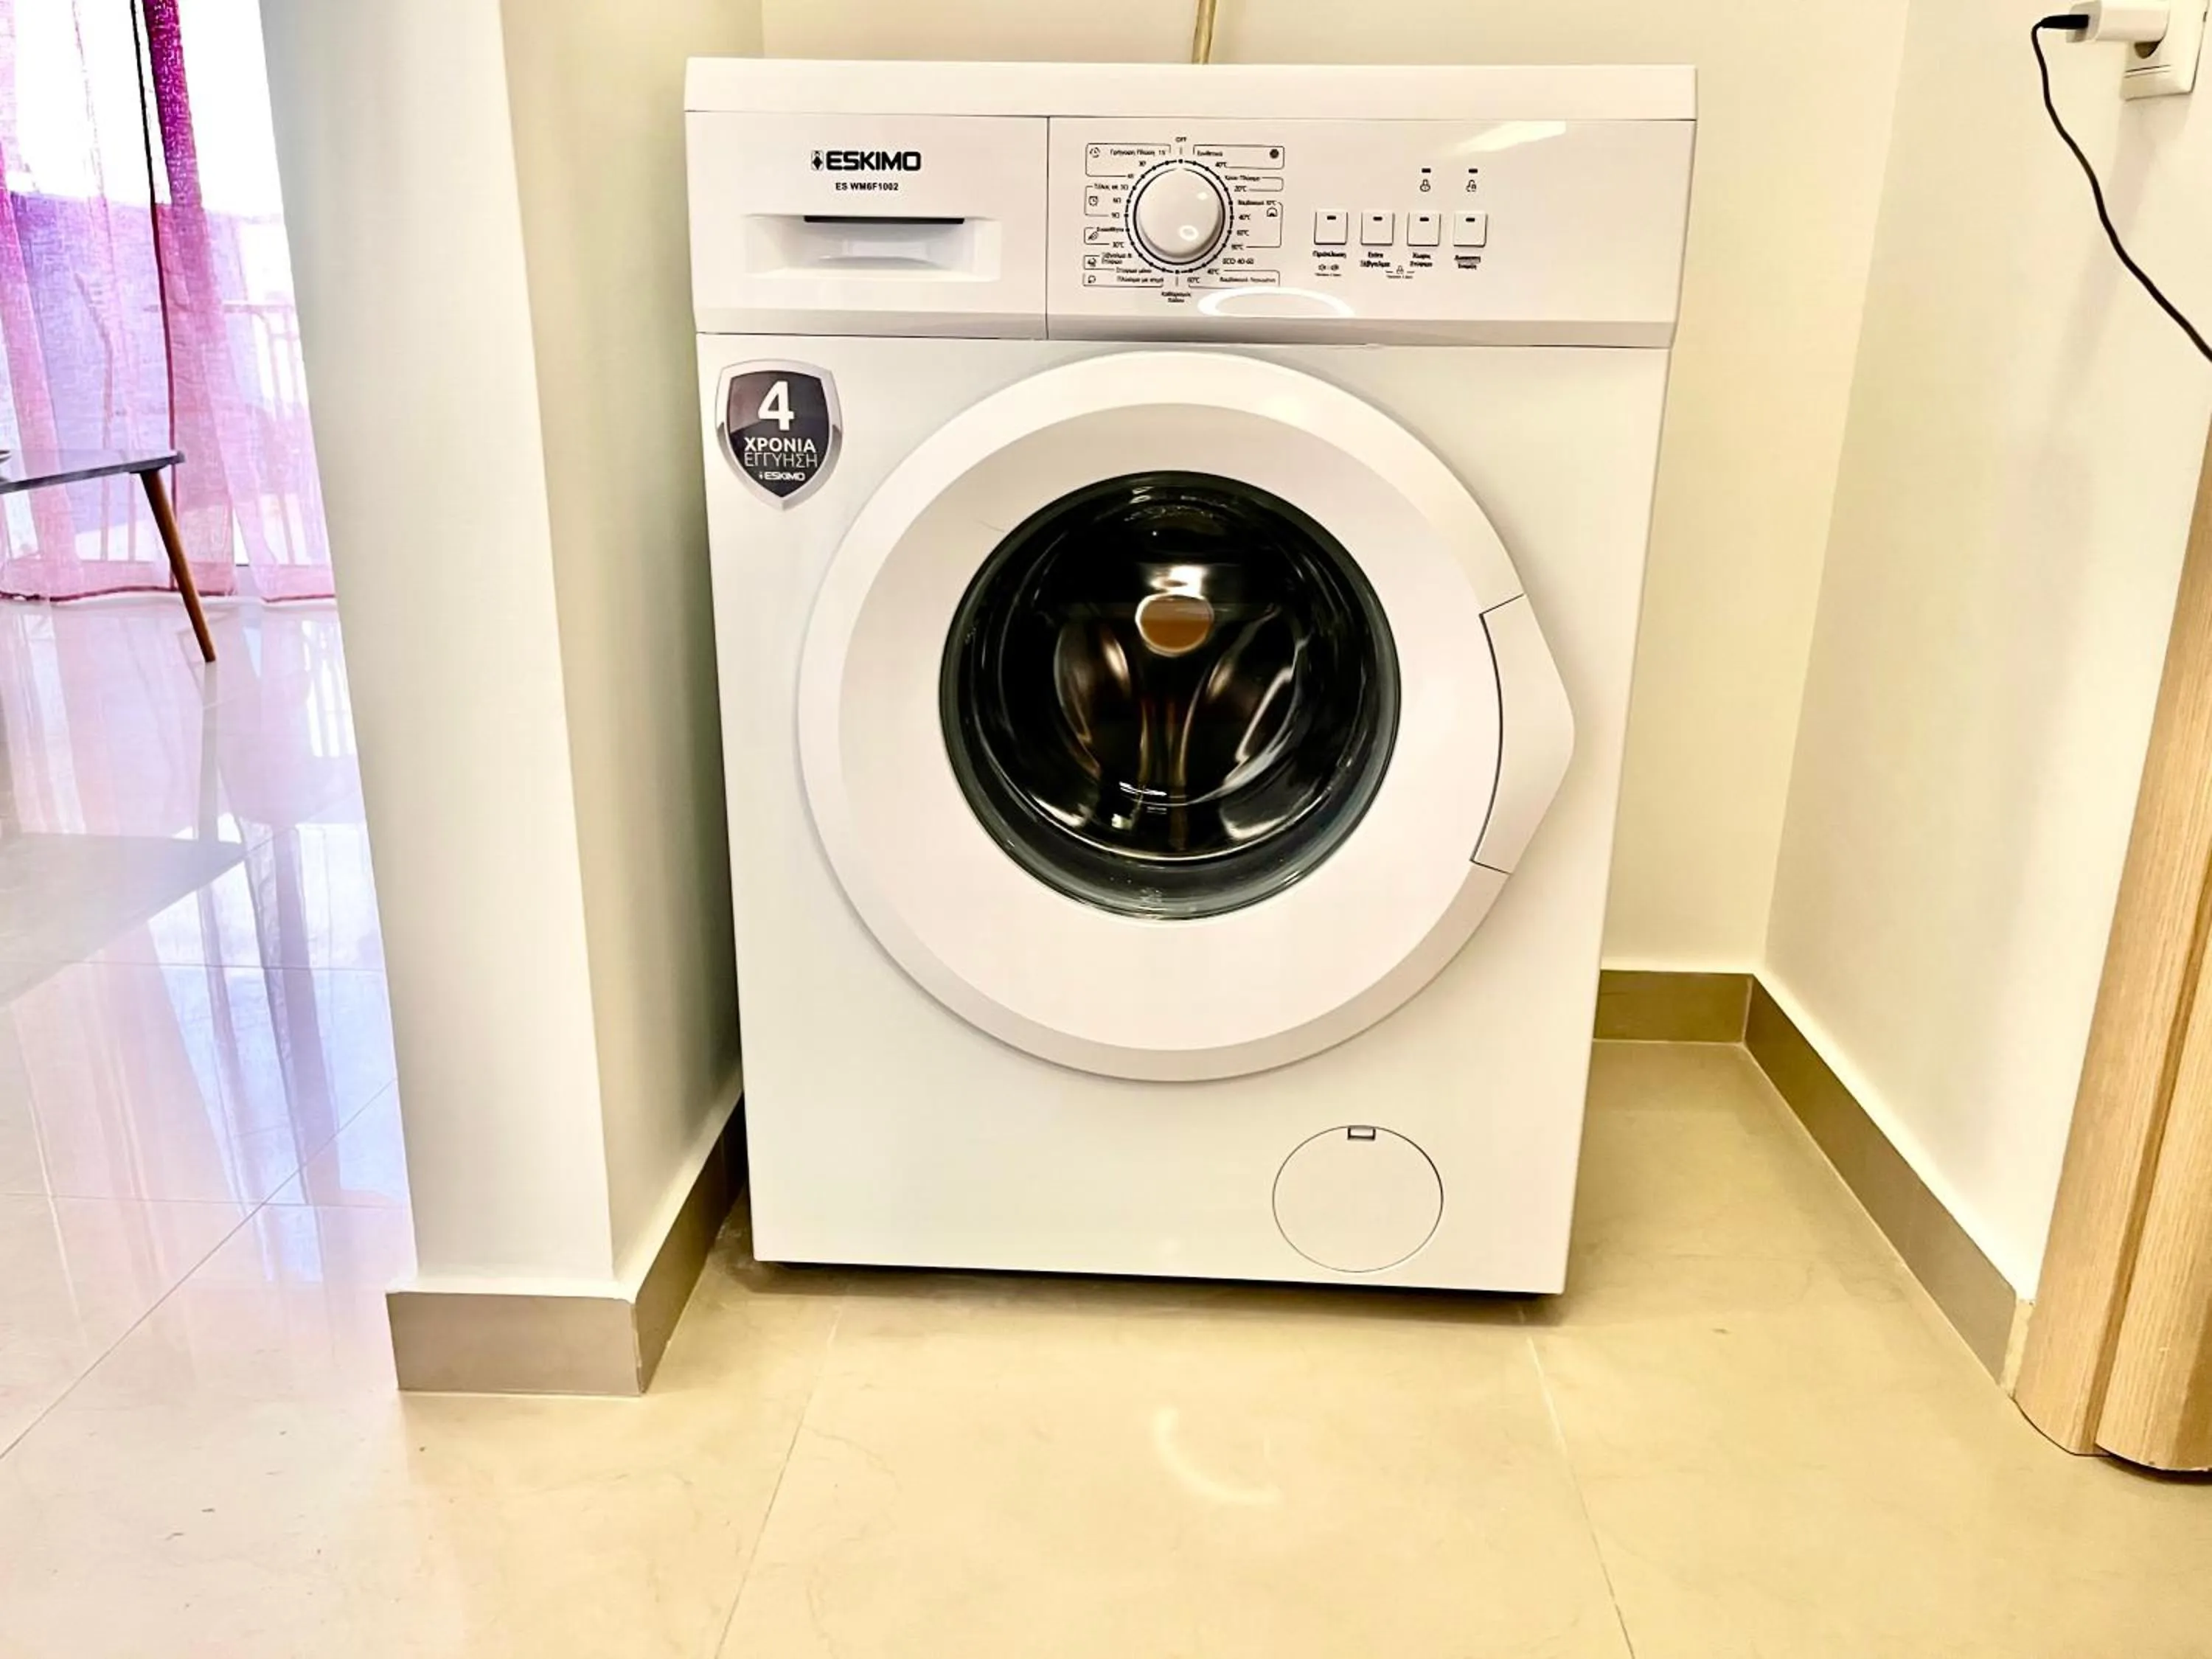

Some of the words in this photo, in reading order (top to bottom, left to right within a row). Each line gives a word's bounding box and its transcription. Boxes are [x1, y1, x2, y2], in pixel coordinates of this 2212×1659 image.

[826, 150, 921, 170] ESKIMO
[835, 182, 847, 190] ES
[758, 381, 794, 431] 4
[744, 437, 816, 453] ΧΡΟΝΙΑ
[744, 452, 818, 468] ΕΓΓΥΗΣΗ
[765, 471, 806, 481] ESKIMO
